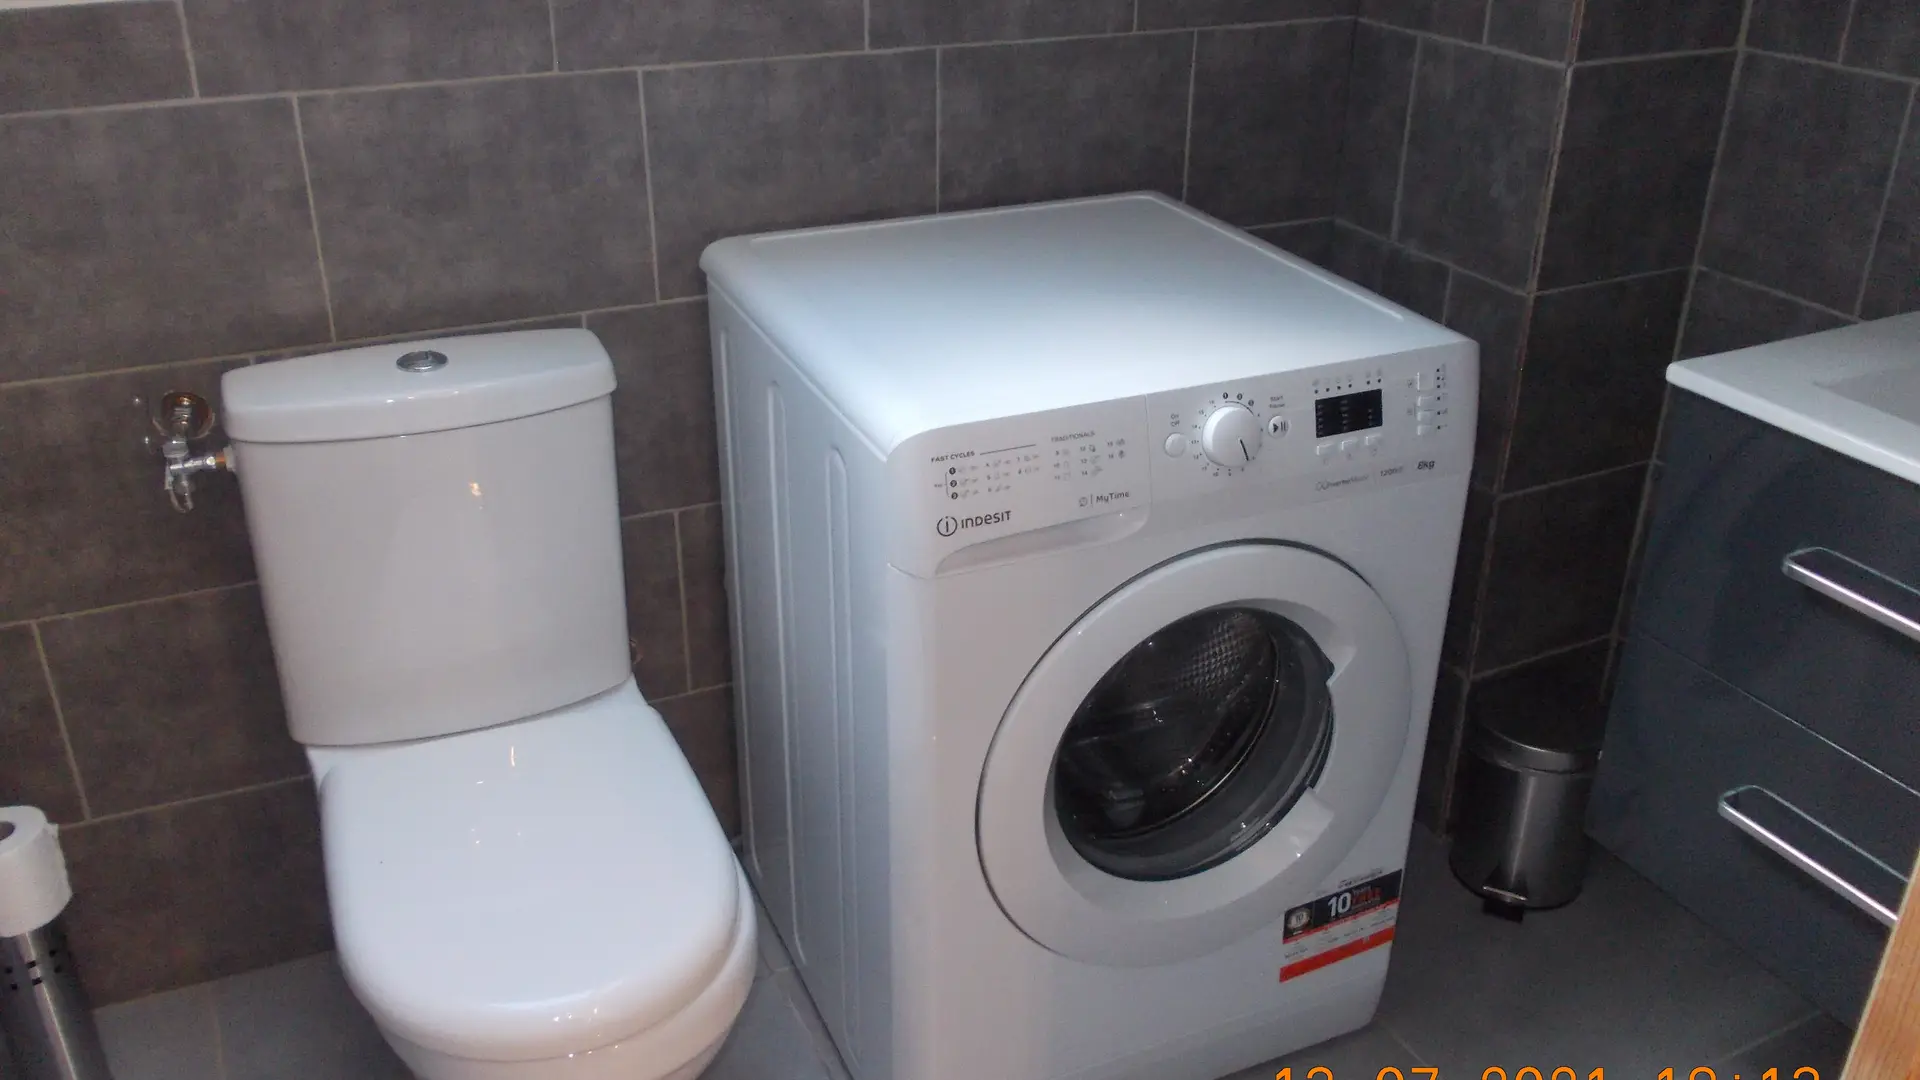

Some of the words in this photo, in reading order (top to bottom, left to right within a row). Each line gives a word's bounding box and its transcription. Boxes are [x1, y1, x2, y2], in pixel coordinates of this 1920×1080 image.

[1051, 431, 1096, 442] TRADITIONALS
[931, 455, 948, 463] FAST
[950, 450, 975, 460] CYCLES
[1096, 491, 1130, 503] MyTime
[1327, 892, 1352, 917] 10
